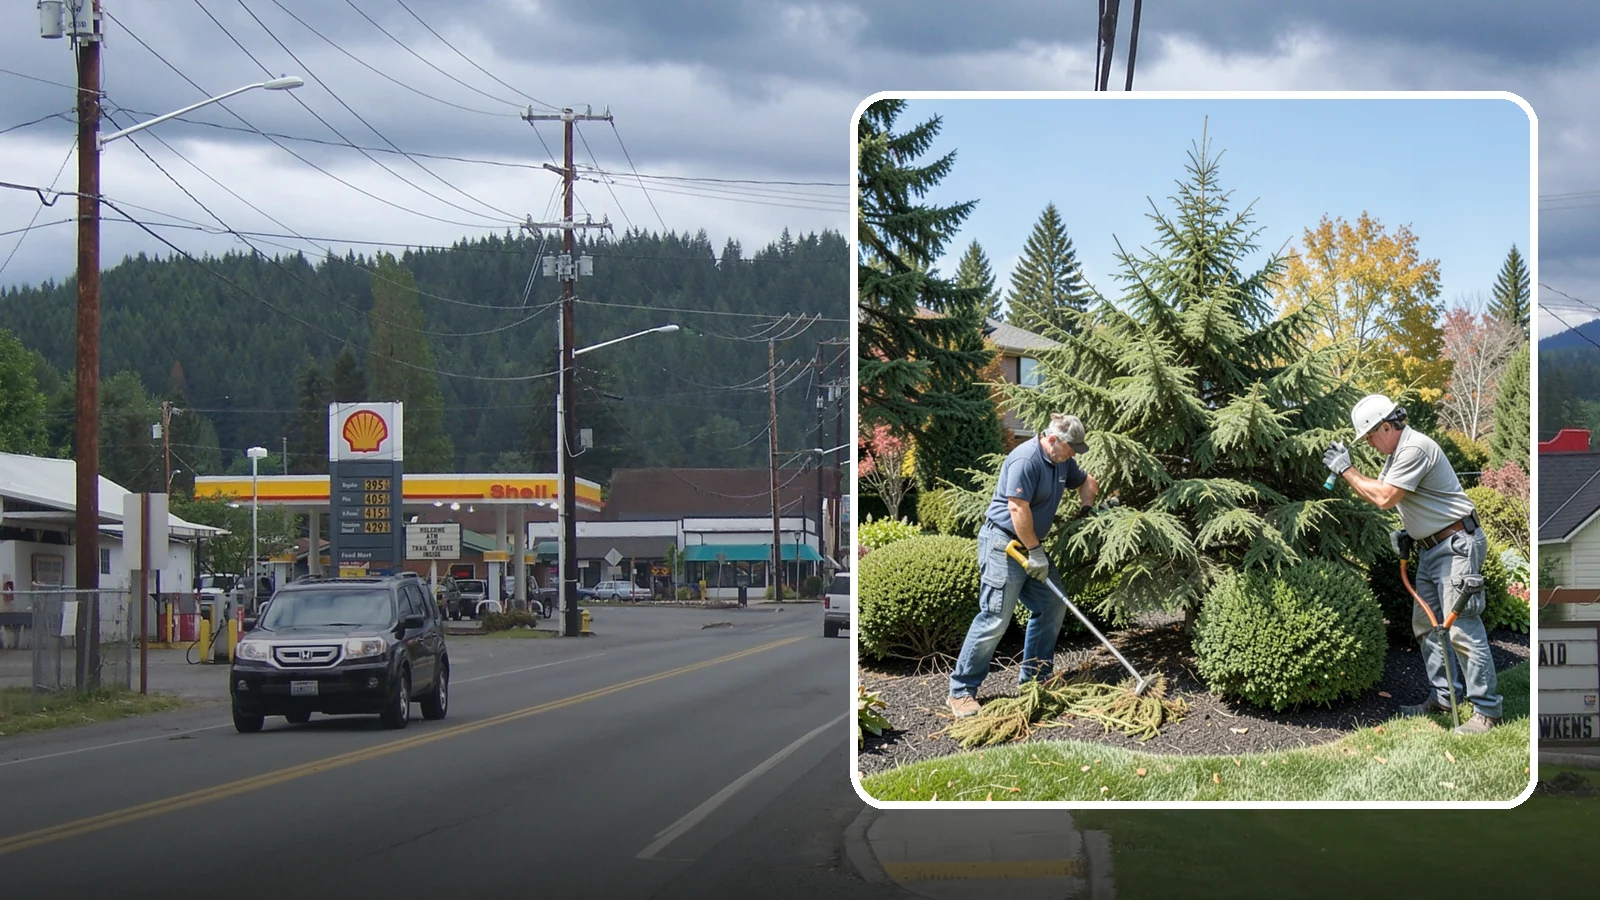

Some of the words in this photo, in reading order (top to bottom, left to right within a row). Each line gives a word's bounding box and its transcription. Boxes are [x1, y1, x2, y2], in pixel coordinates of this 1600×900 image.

[366, 480, 383, 490] 395
[490, 484, 547, 499] Shell
[366, 494, 383, 504] 405
[366, 508, 383, 518] 415
[366, 522, 384, 532] 429
